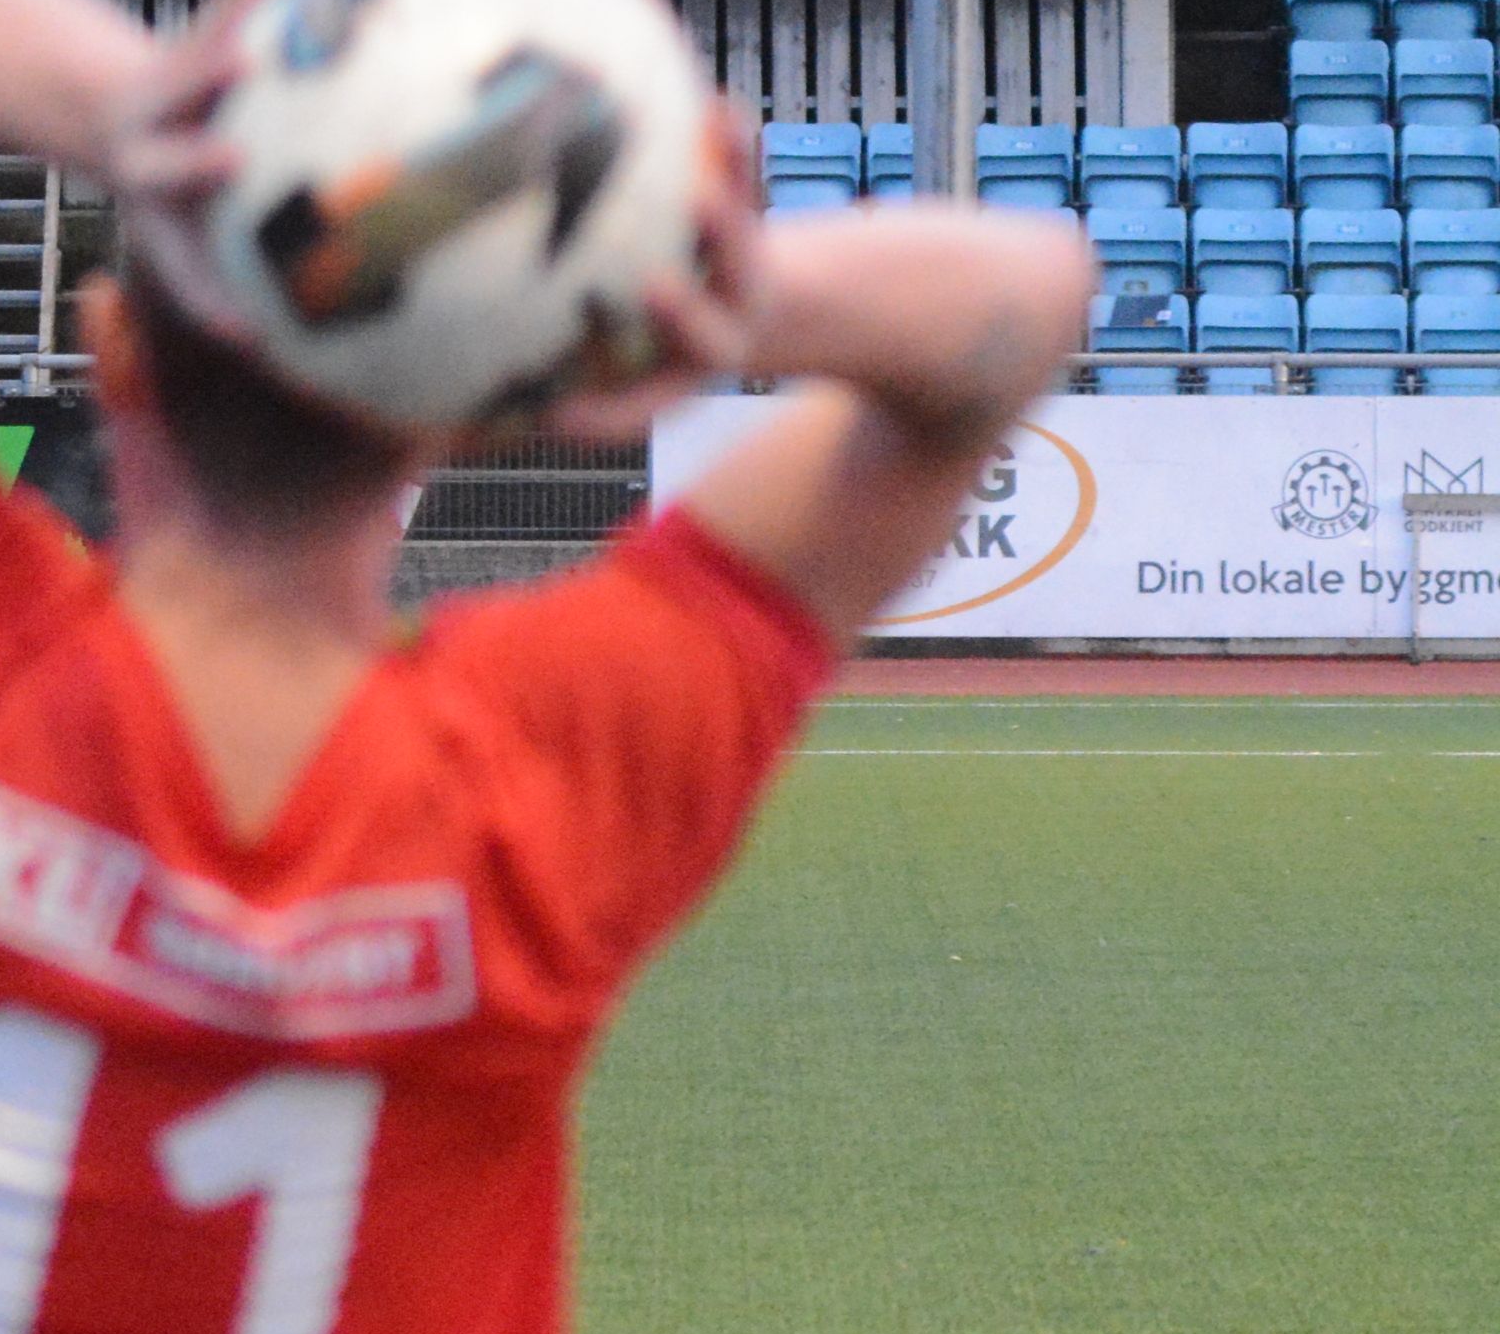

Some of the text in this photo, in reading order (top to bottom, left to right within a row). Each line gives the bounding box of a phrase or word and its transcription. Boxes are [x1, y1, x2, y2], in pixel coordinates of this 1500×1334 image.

[1289, 509, 1364, 536] MESTER
[1137, 559, 1500, 605] Din lokale byggm
